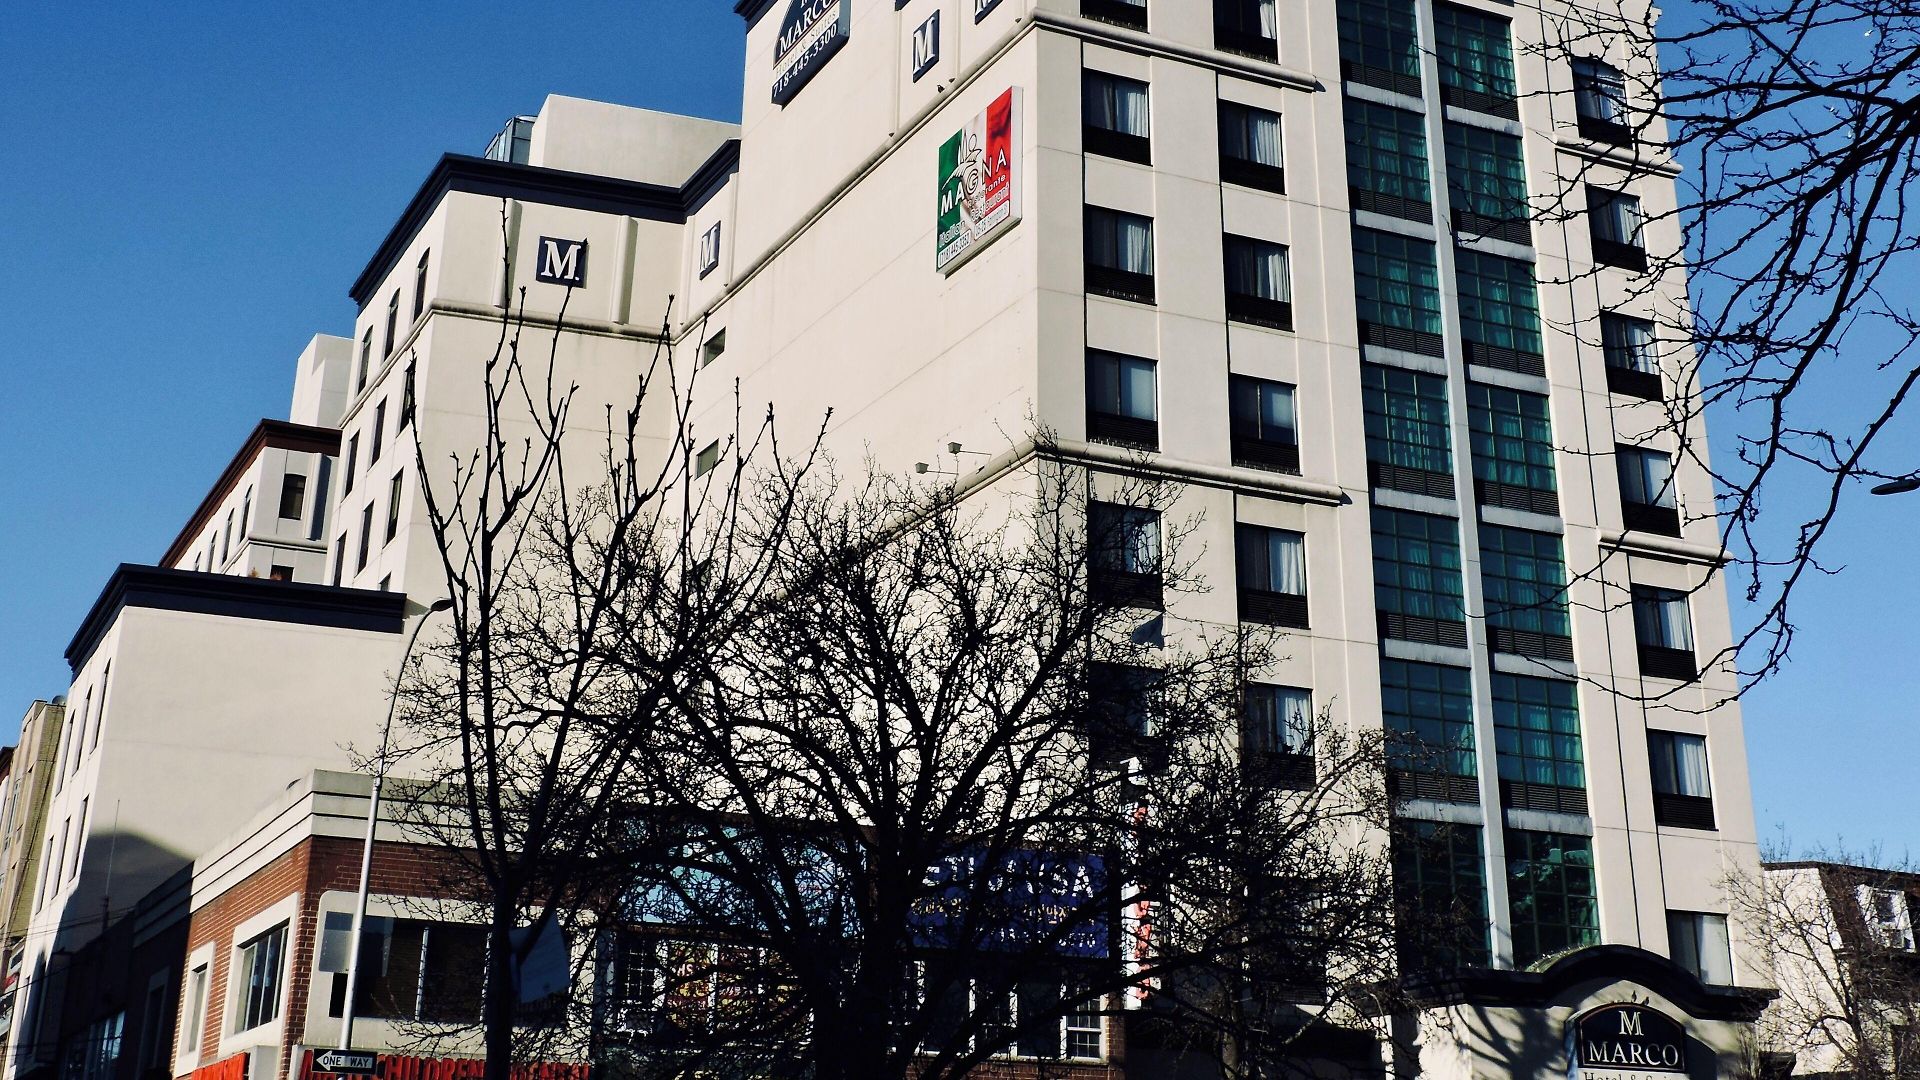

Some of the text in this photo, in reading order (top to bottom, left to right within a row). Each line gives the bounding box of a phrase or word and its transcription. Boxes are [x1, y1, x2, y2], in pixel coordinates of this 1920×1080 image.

[773, 23, 837, 98] 718-445-3300
[913, 16, 935, 75] M
[940, 148, 1007, 217] MAGNA
[540, 240, 583, 281] M
[1618, 1010, 1644, 1036] M
[323, 1056, 369, 1067] ONE WAY
[1589, 1040, 1679, 1067] MARCO
